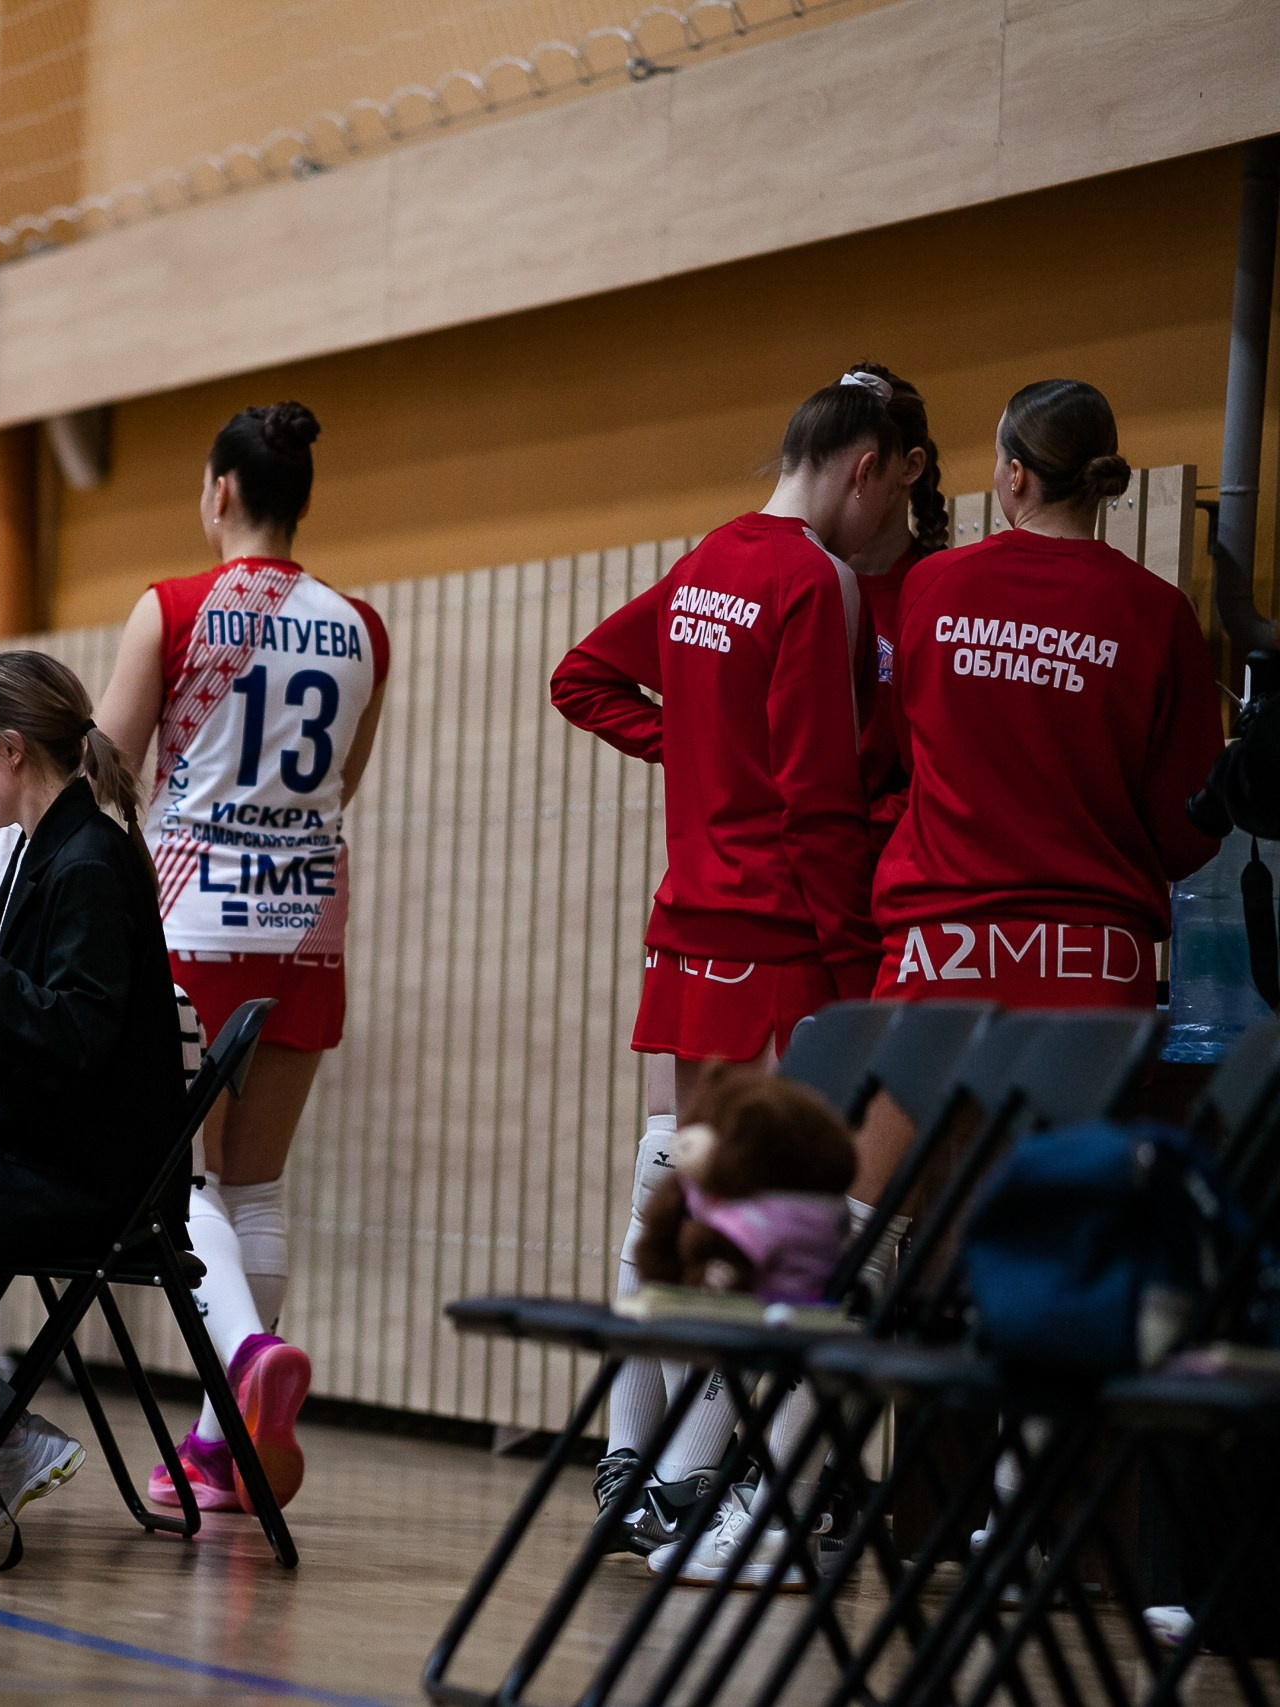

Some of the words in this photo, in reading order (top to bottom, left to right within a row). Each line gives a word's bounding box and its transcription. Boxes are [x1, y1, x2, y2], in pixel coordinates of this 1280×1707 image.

[670, 585, 762, 629] САМАРСКАЯ
[207, 610, 363, 662] ПОТАТУЕВА
[669, 615, 732, 653] ОБЛАСТЬ
[935, 615, 1119, 668] САМАРСКАЯ
[953, 648, 1085, 693] ОБЛАСТЬ
[232, 664, 340, 795] 13
[210, 802, 324, 830] ИСКРА
[256, 901, 323, 915] GLOBAL
[256, 916, 317, 928] VISION
[896, 922, 1140, 983] A2MED
